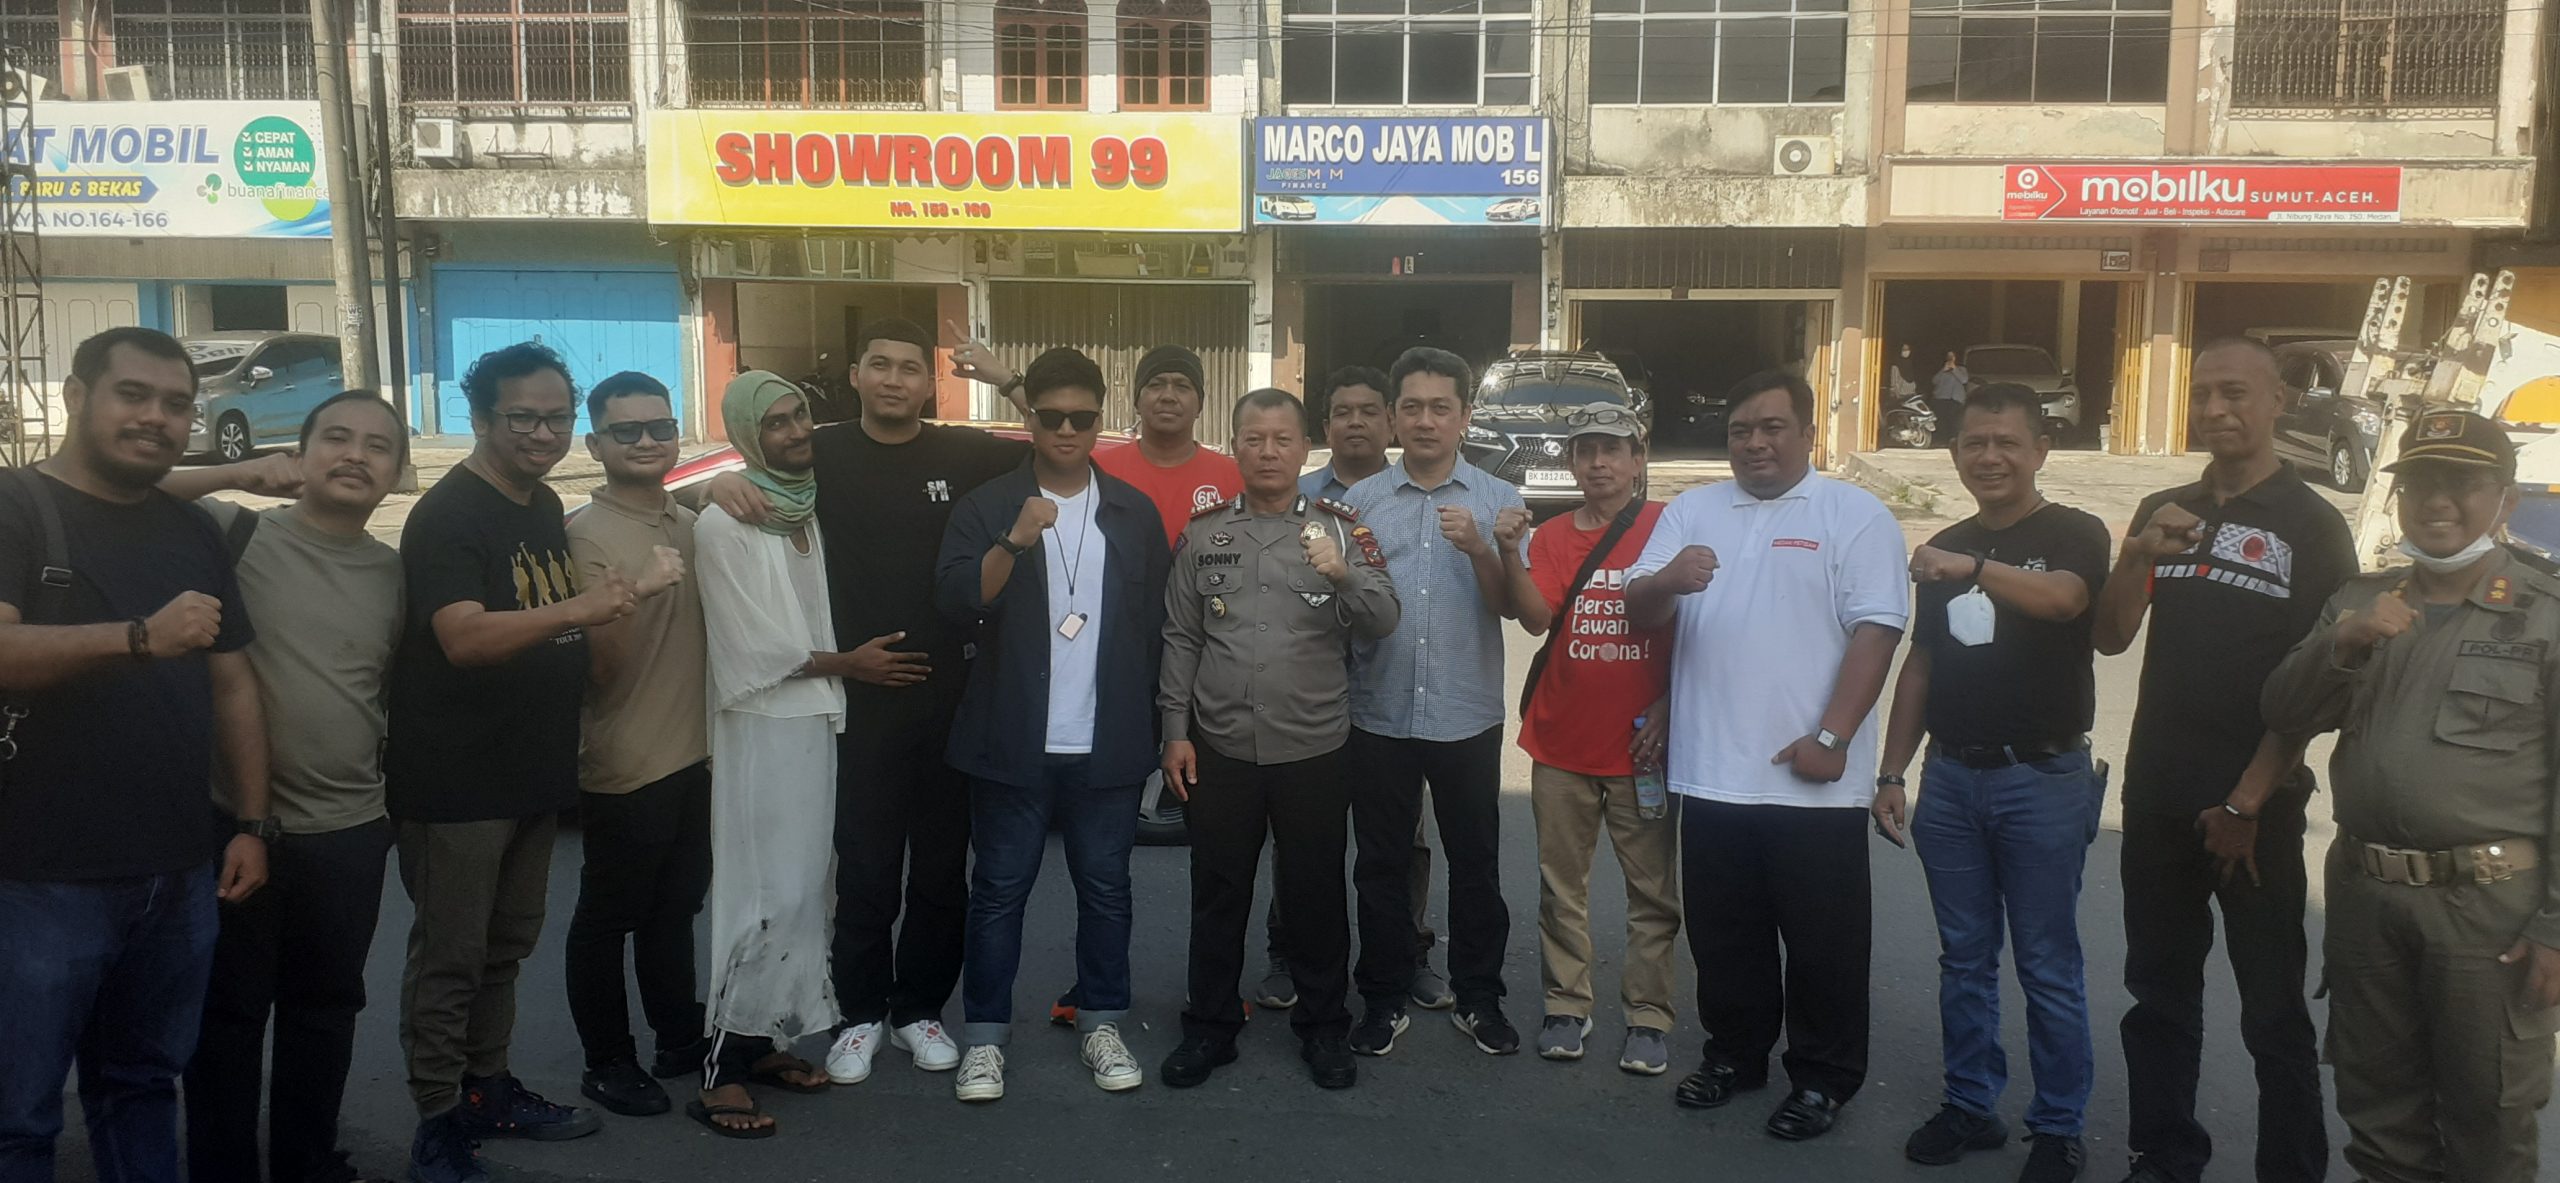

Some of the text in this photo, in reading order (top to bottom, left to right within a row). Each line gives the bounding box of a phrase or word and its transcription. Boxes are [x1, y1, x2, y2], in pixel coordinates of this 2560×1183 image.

[255, 132, 295, 143] CEPAT
[1264, 125, 1364, 163] MARCO
[1372, 125, 1443, 163] JAYA
[69, 127, 219, 164] MOBIL
[257, 147, 294, 158] AMAN
[257, 162, 310, 172] NYAMAN
[715, 132, 1169, 191] SHOWROOM 99
[1501, 169, 1540, 184] 156
[69, 181, 81, 196] &
[87, 181, 142, 196] BEKAS
[227, 181, 330, 199] buanafinance
[2082, 170, 2246, 202] mobilku
[2007, 191, 2048, 199] mobilku
[2080, 207, 2108, 216] Layanan
[2110, 207, 2139, 215] Otomotif
[2216, 208, 2246, 216] Autocare
[53, 210, 167, 228] NO.164-166
[1528, 472, 1539, 480] BK
[1540, 472, 1559, 480] 1812
[927, 480, 946, 491] SM
[928, 491, 949, 502] TH
[1198, 553, 1241, 566] SONNY
[1571, 614, 1629, 635] Lawan
